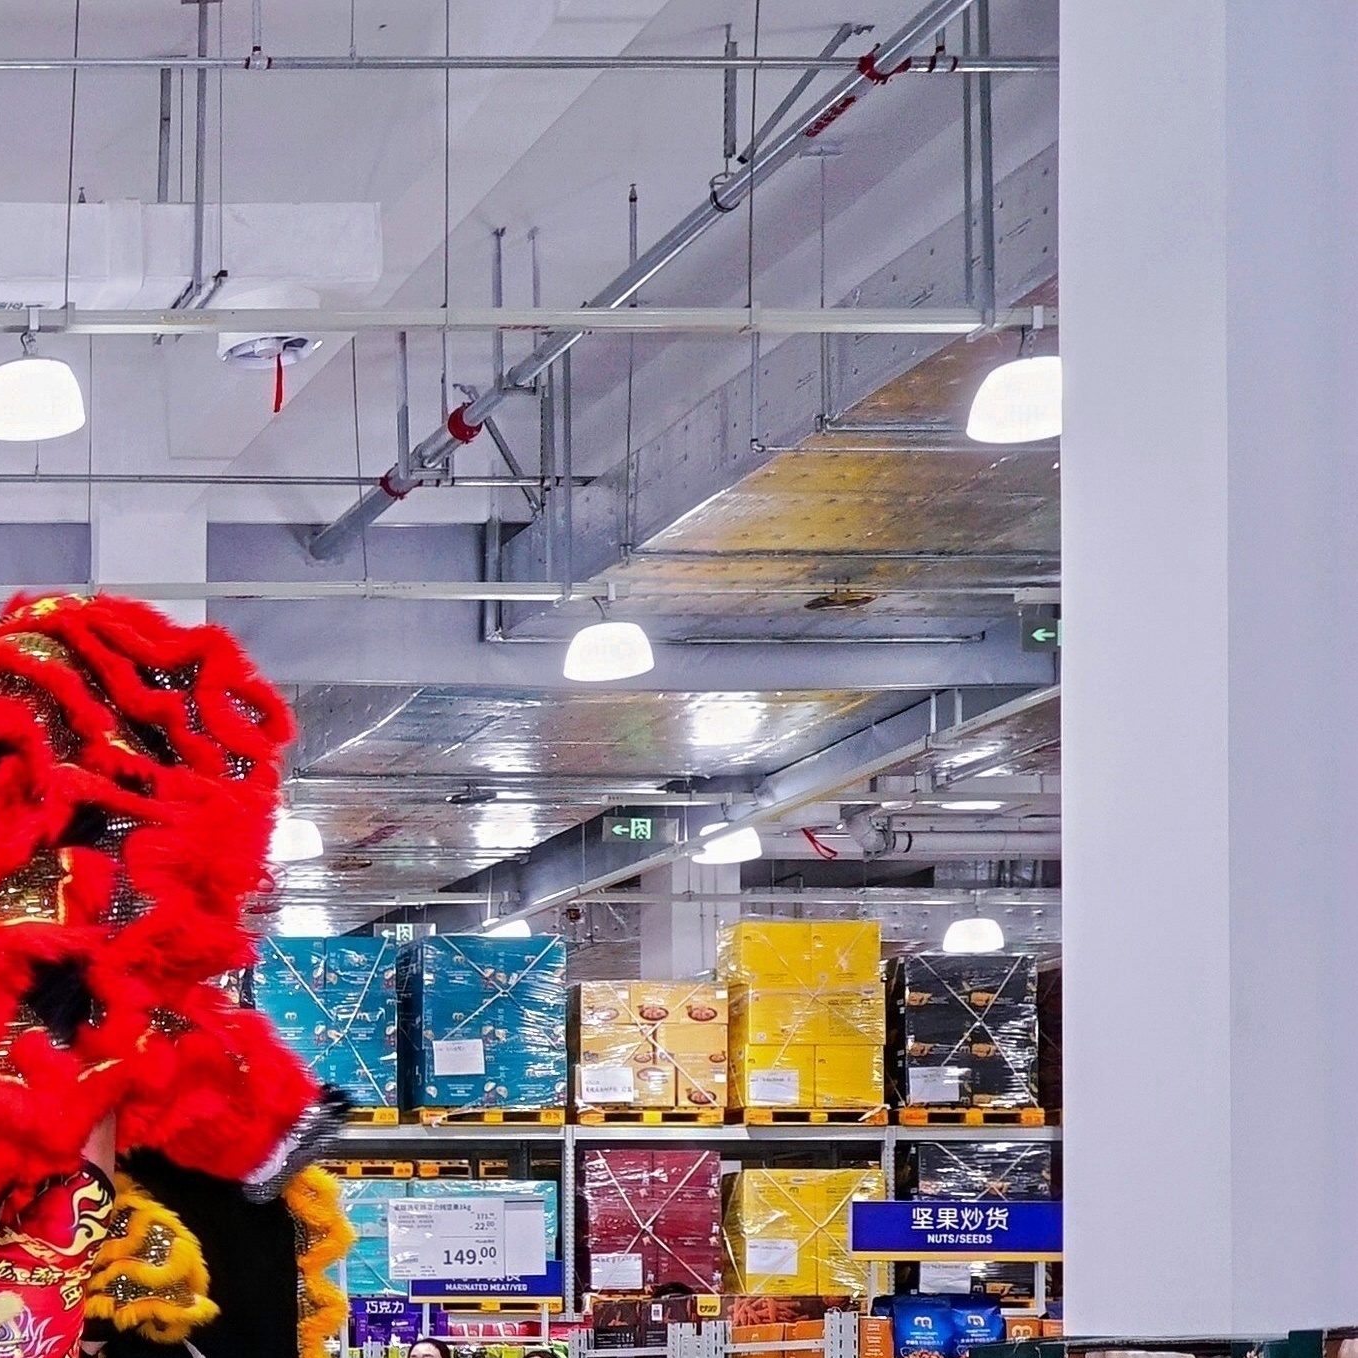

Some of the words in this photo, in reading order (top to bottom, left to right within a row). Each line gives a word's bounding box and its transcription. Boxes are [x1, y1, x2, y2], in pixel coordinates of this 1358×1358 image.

[911, 1207, 1009, 1231] 坚果炒货
[926, 1234, 993, 1244] NUTS/SEEDS
[443, 1246, 497, 1265] 149.00
[445, 1283, 490, 1292] MARINATED
[365, 1300, 405, 1314] 巧克力
